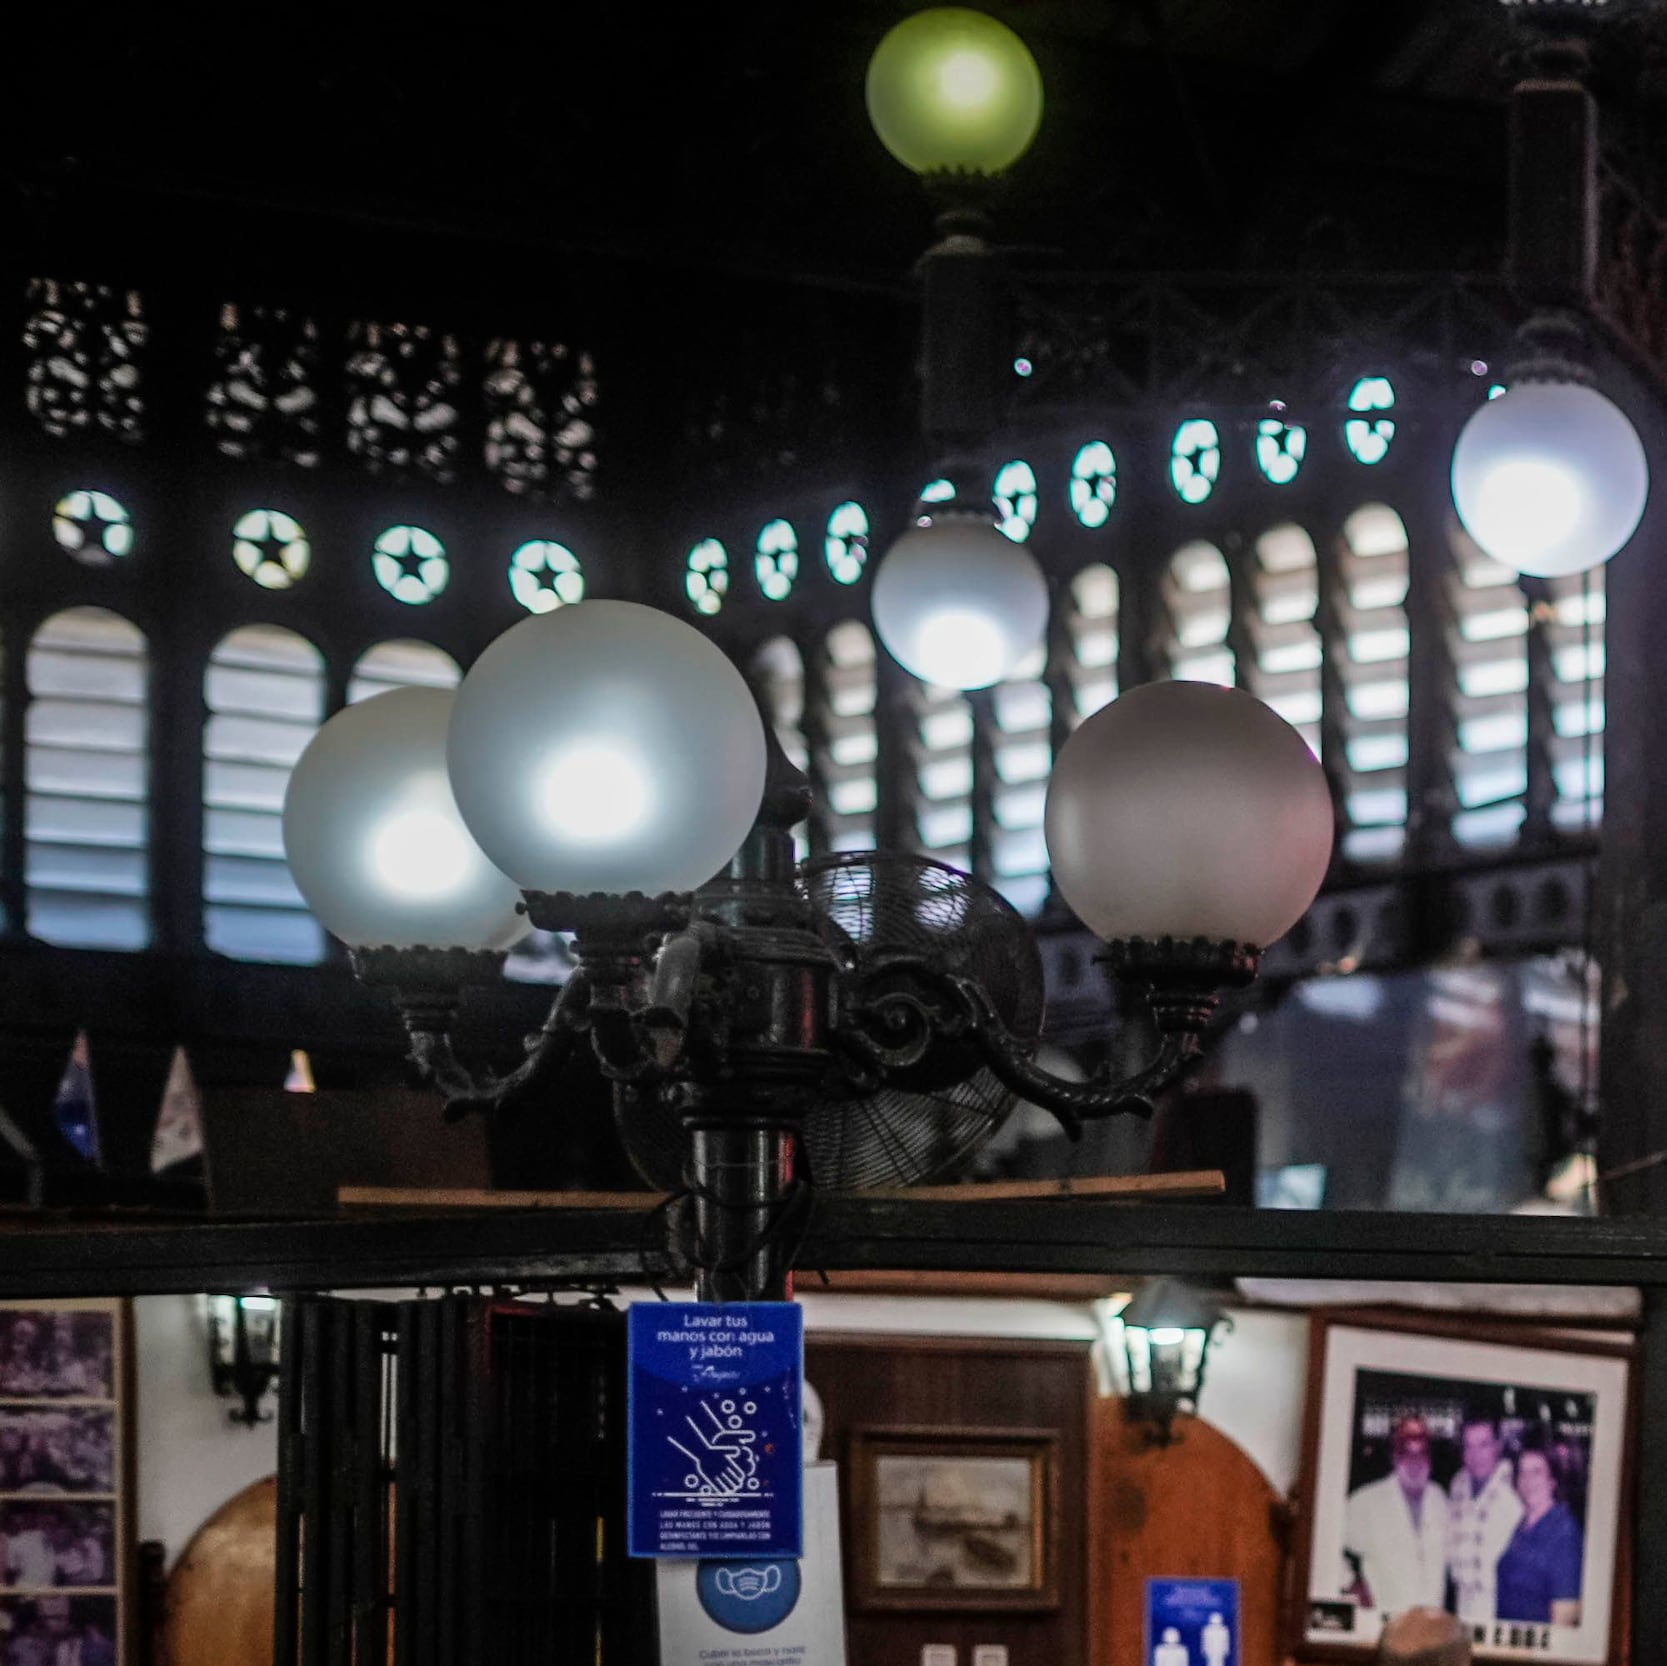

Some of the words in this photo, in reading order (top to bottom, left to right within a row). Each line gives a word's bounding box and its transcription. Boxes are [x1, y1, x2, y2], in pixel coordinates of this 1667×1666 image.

[684, 1314, 722, 1327] Lavar
[726, 1315, 748, 1327] tus
[657, 1331, 706, 1342] manos
[709, 1331, 736, 1342] con
[739, 1331, 774, 1345] agua
[690, 1347, 698, 1359] y
[700, 1344, 742, 1358] jabón
